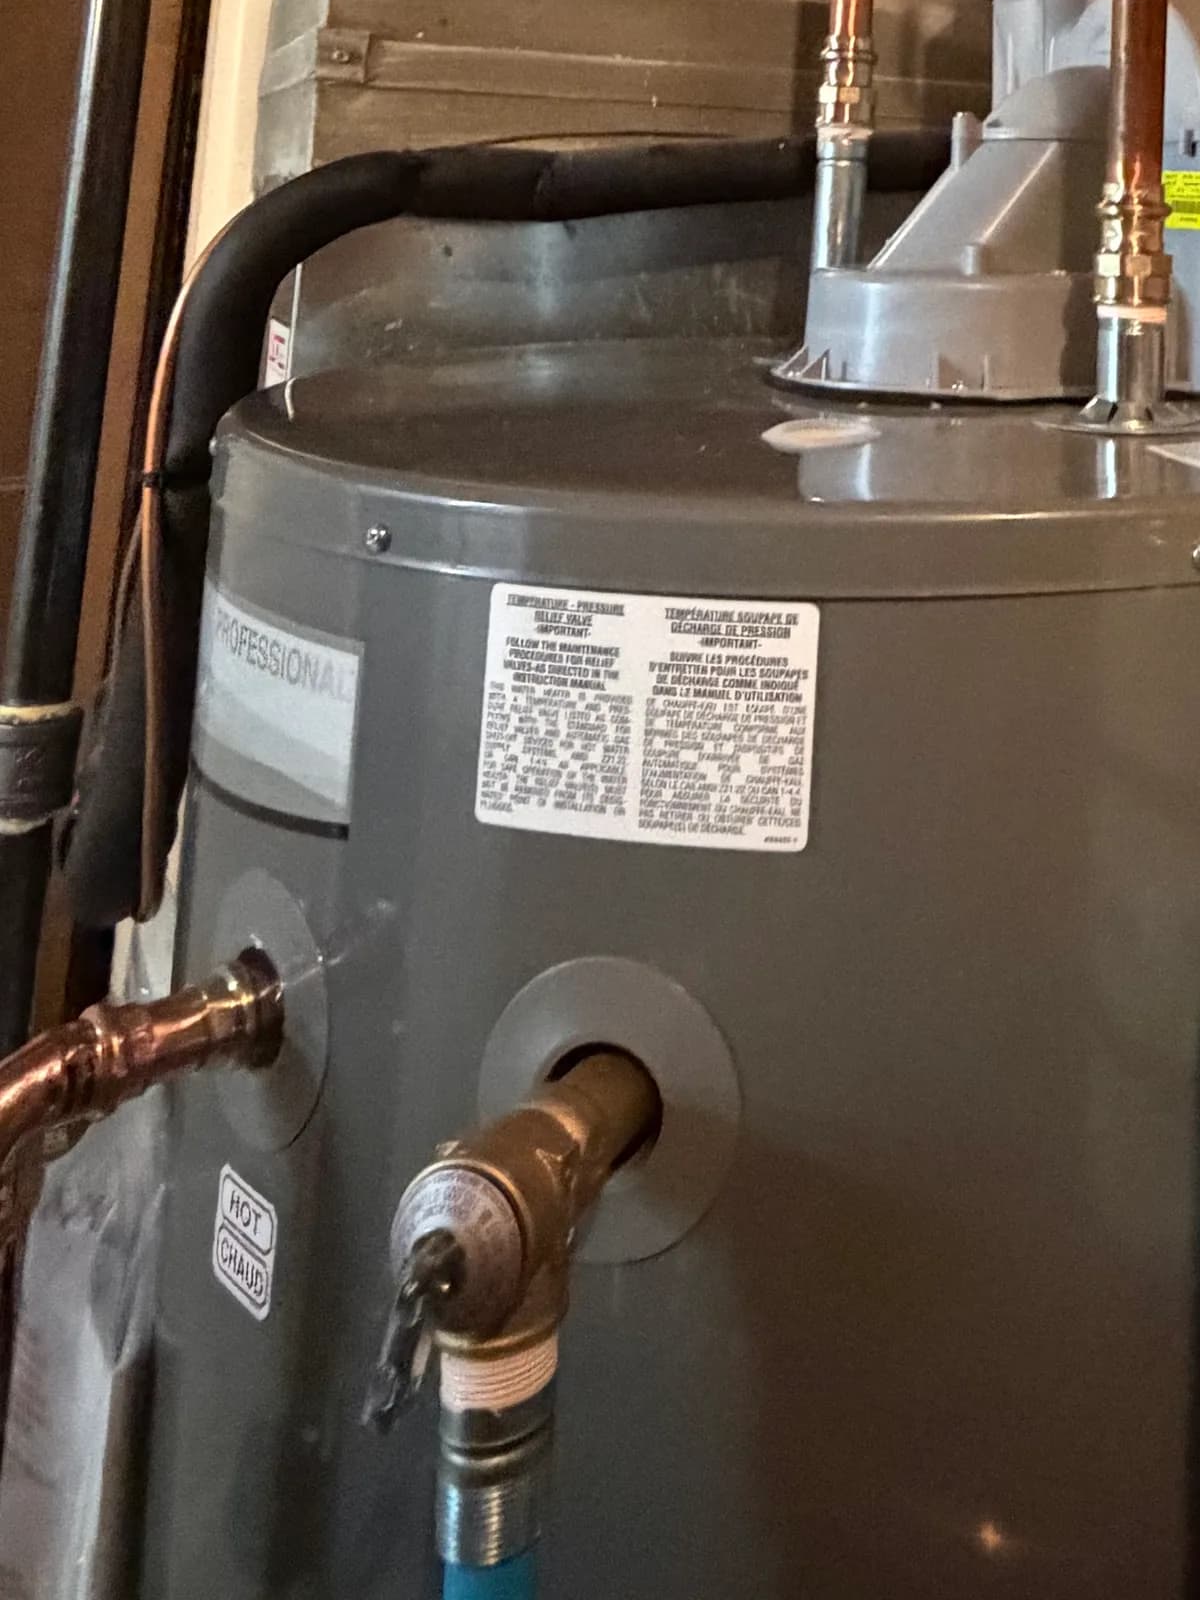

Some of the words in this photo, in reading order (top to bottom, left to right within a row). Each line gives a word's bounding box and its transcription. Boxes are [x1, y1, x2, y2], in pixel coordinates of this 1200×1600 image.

[214, 608, 356, 704] PROFESSIONAL
[229, 1190, 262, 1236] HOT
[220, 1239, 264, 1297] CHAUD
